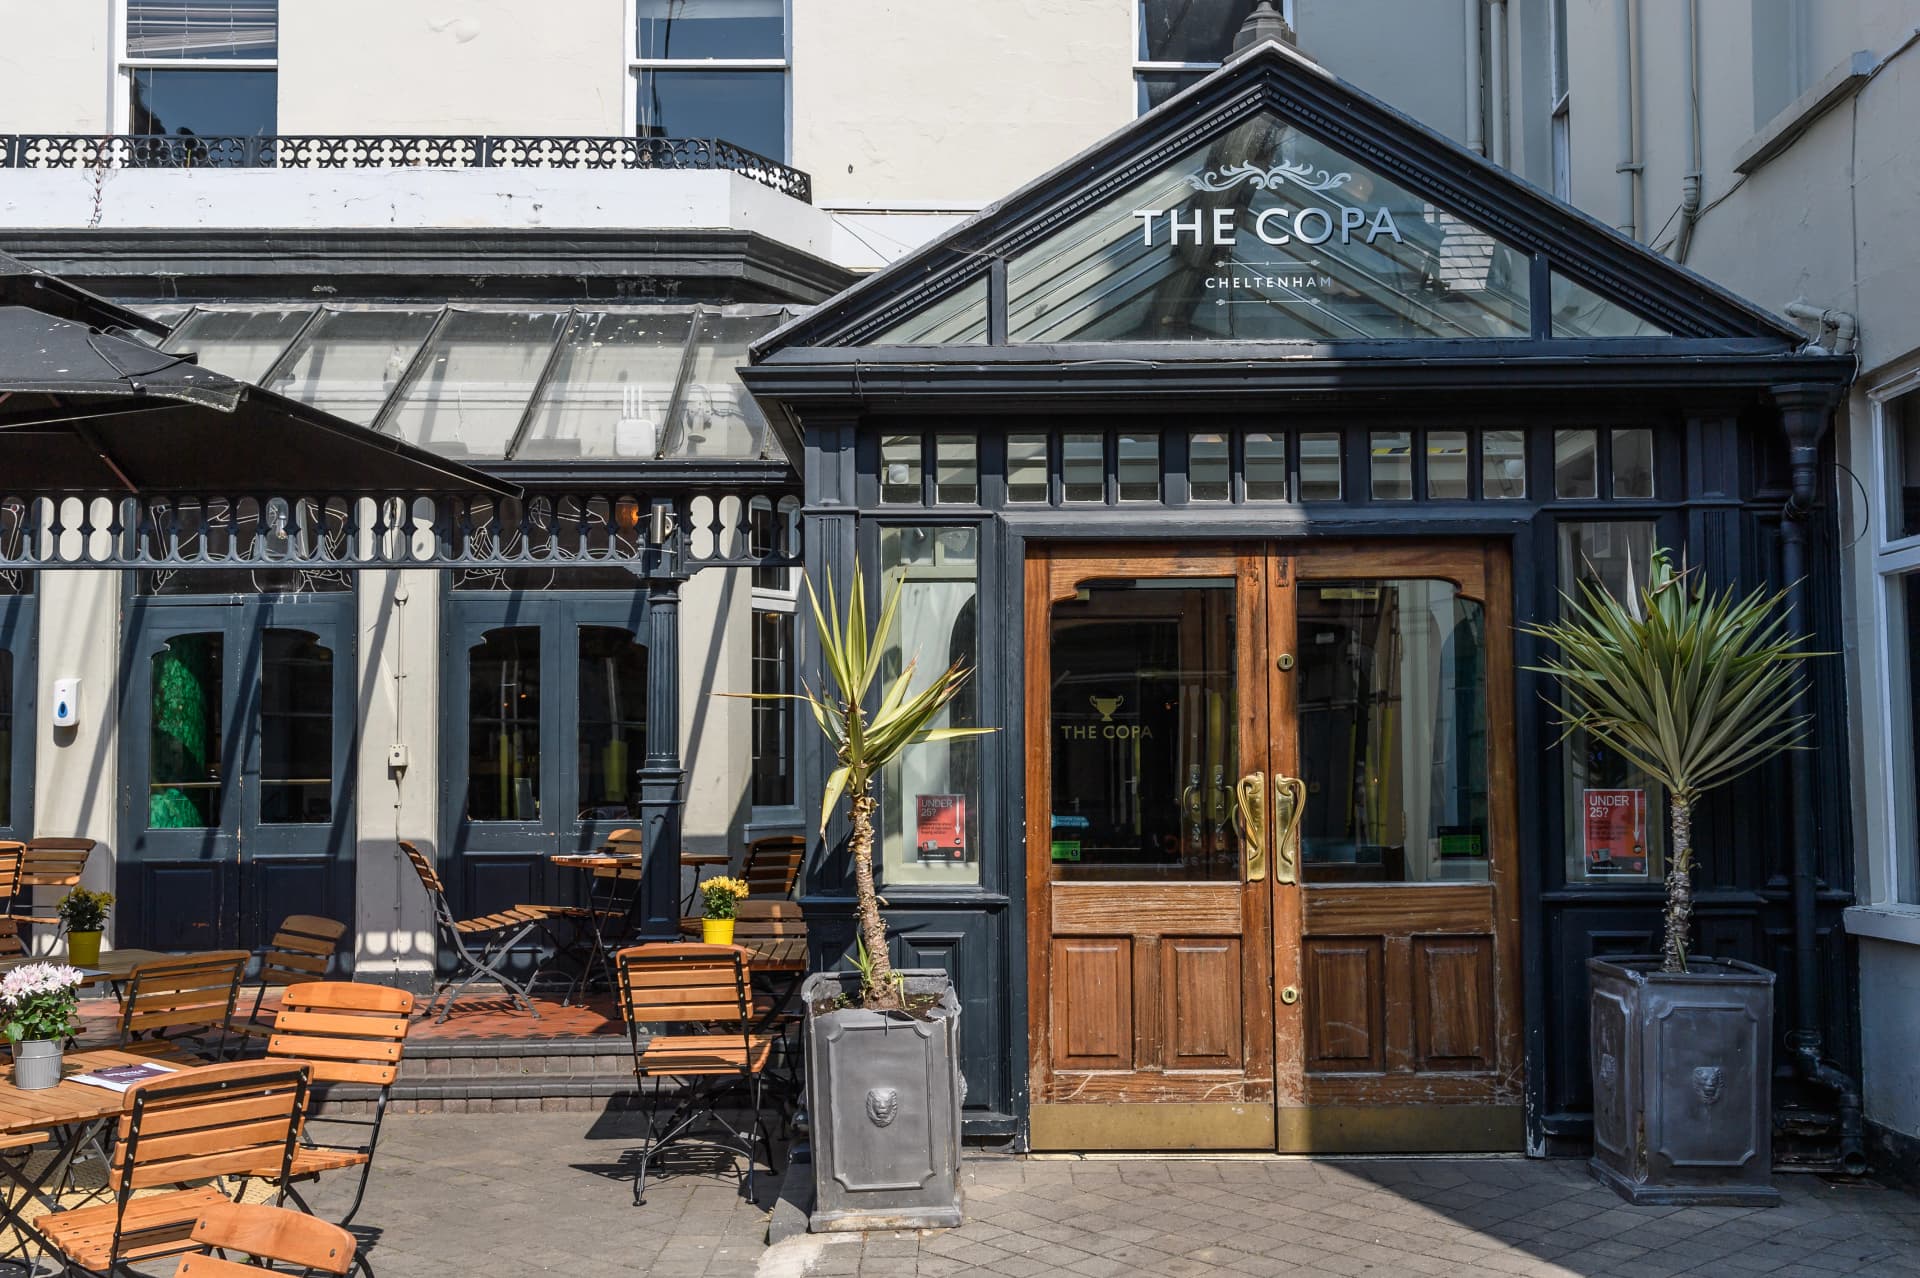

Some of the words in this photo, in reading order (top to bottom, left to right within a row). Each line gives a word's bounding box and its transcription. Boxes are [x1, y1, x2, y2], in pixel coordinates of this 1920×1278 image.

[1132, 207, 1237, 247] THE
[1255, 206, 1404, 246] COPA
[1205, 276, 1332, 289] CHELTENHAM
[1061, 725, 1097, 739] THE
[1103, 725, 1153, 739] COPA
[921, 799, 953, 808] UNDER
[1589, 795, 1630, 807] UNDER
[920, 808, 937, 817] 25?
[1589, 807, 1609, 818] 25?
